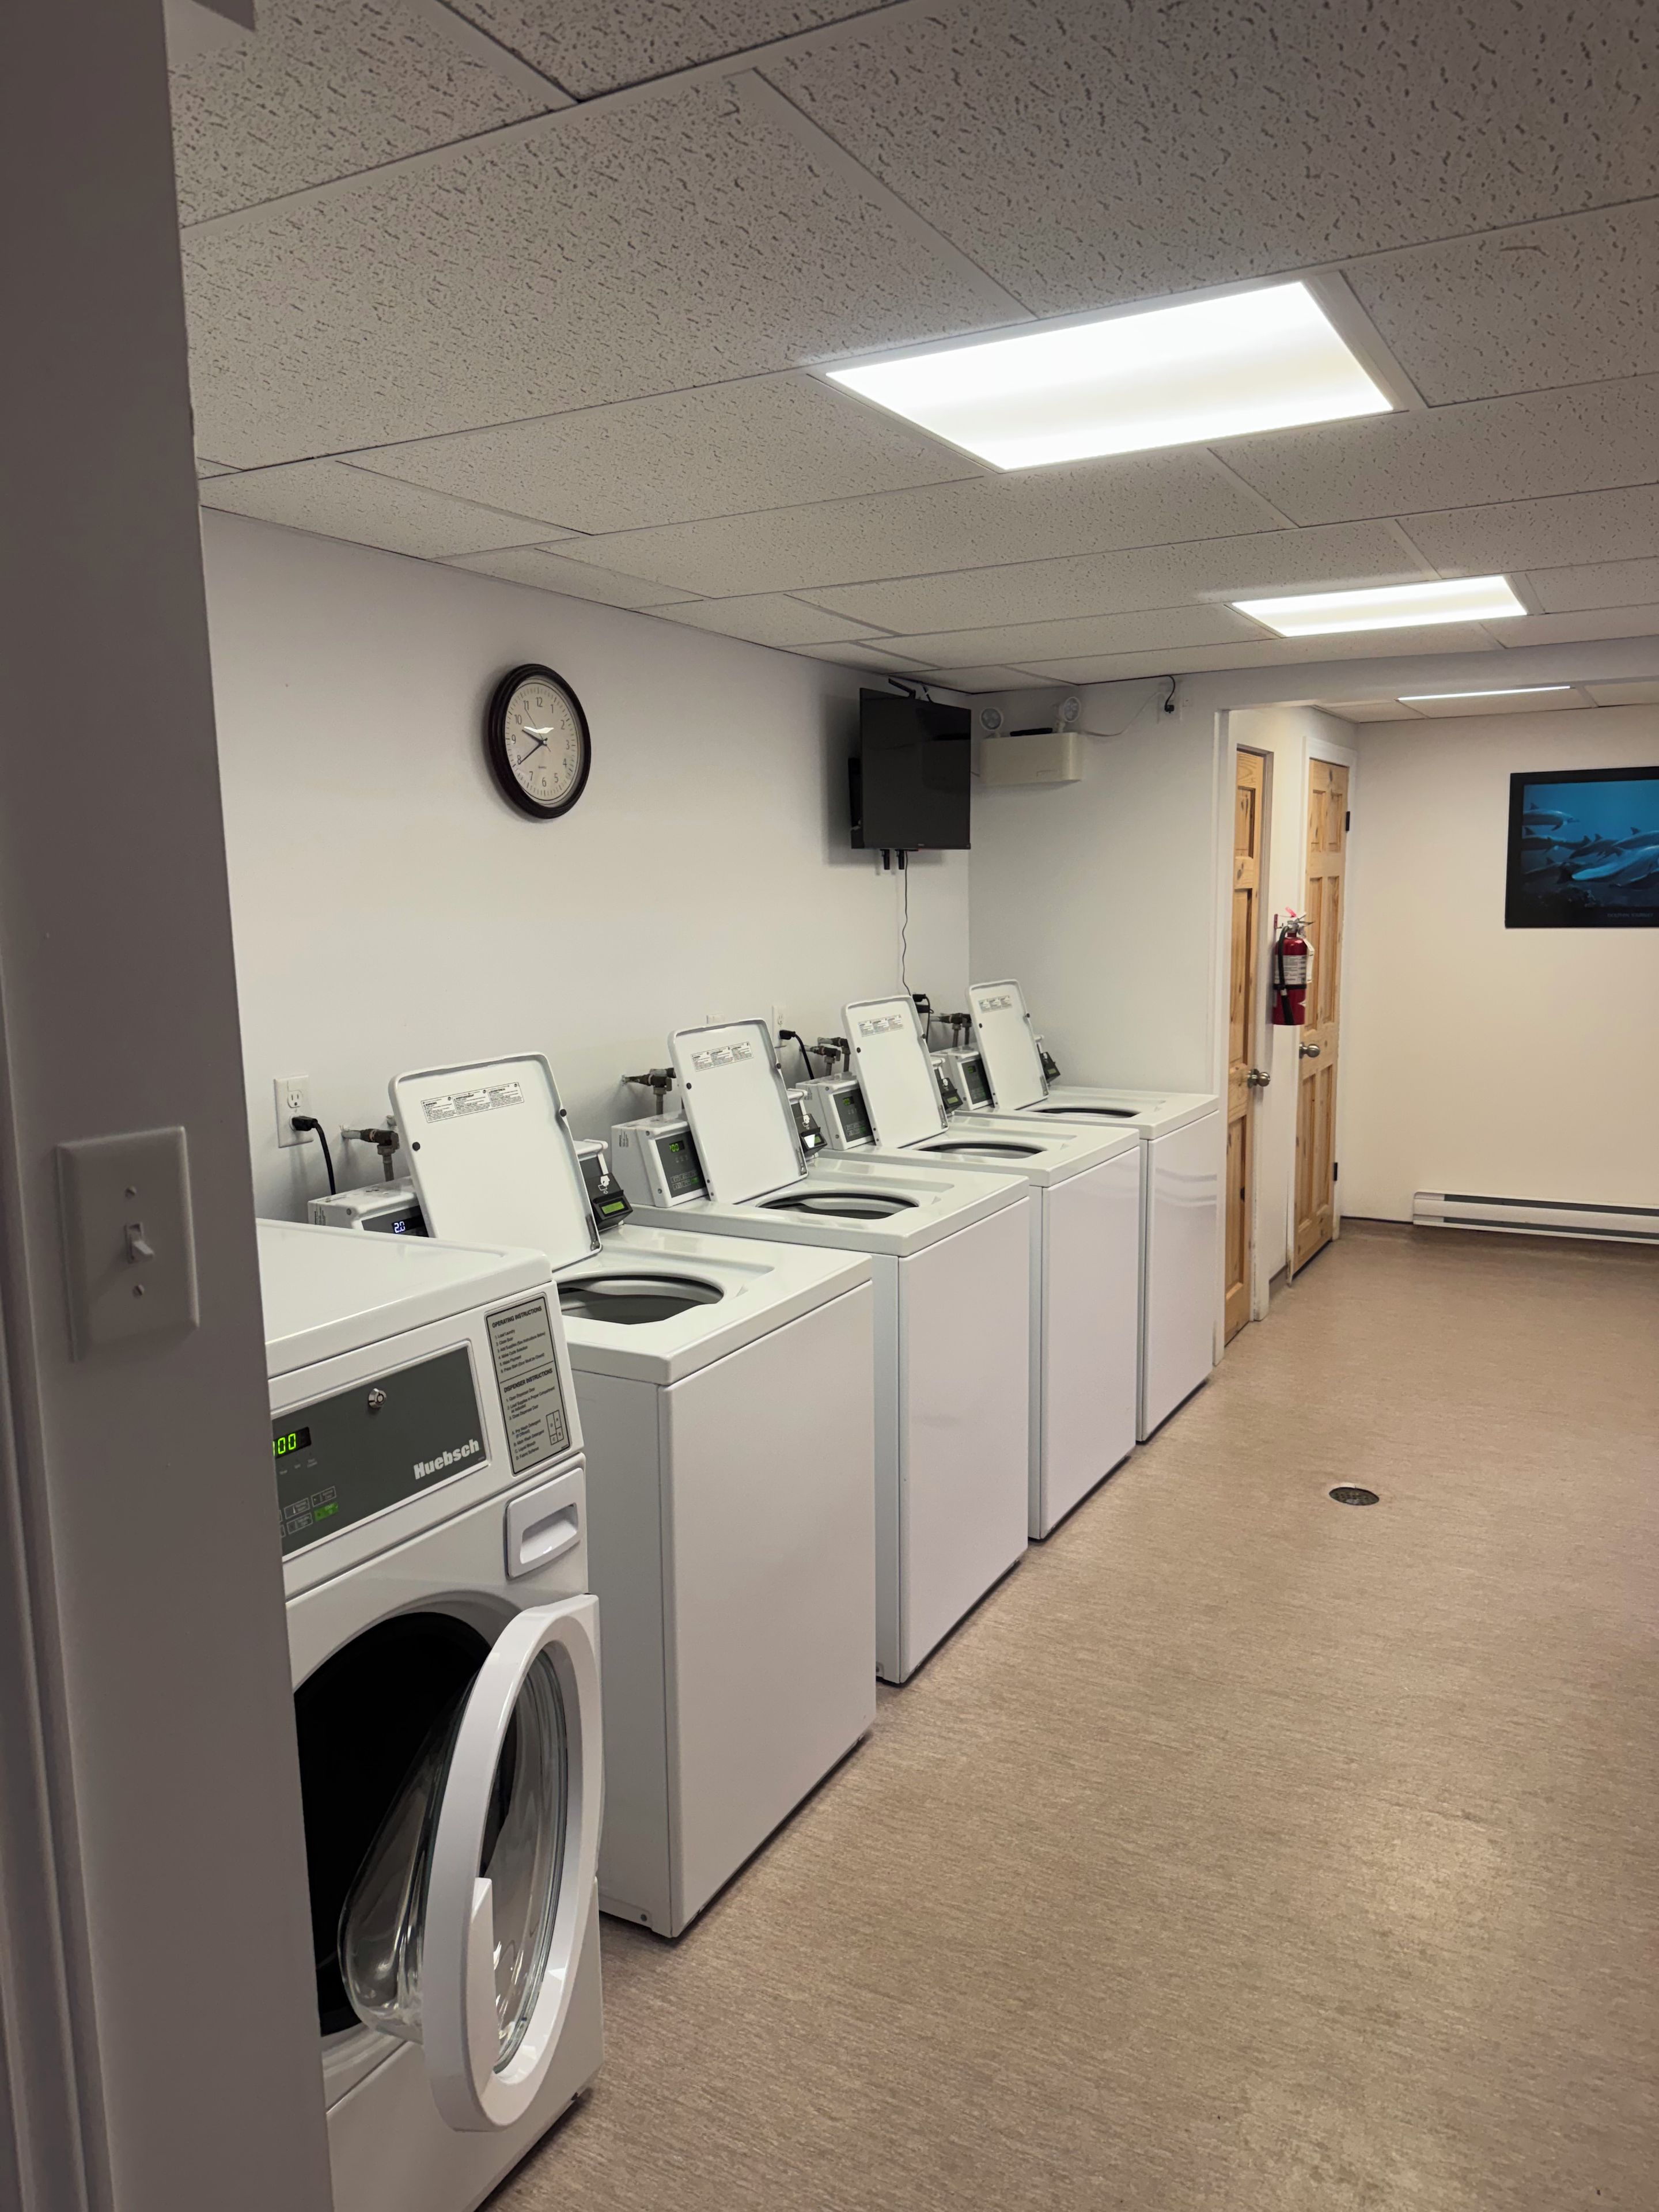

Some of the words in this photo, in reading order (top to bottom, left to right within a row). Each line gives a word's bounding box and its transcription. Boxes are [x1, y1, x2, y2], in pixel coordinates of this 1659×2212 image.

[524, 700, 529, 711] 11
[536, 697, 543, 707] 12
[551, 704, 554, 714] 1
[514, 714, 522, 725] 10
[560, 719, 565, 730] 2
[512, 734, 516, 744] 9
[566, 740, 570, 749] 3
[517, 755, 522, 765] 8
[563, 758, 567, 768] 4
[529, 771, 533, 781] 7
[554, 773, 559, 783] 5
[542, 777, 547, 787] 6
[493, 1316, 514, 1328] OPERATING
[515, 1306, 541, 1320] INSTRUCTIONS
[504, 1379, 526, 1393] DISPENSER
[526, 1368, 552, 1383] INSTRUCTIONS
[413, 1438, 480, 1480] Huebsch
